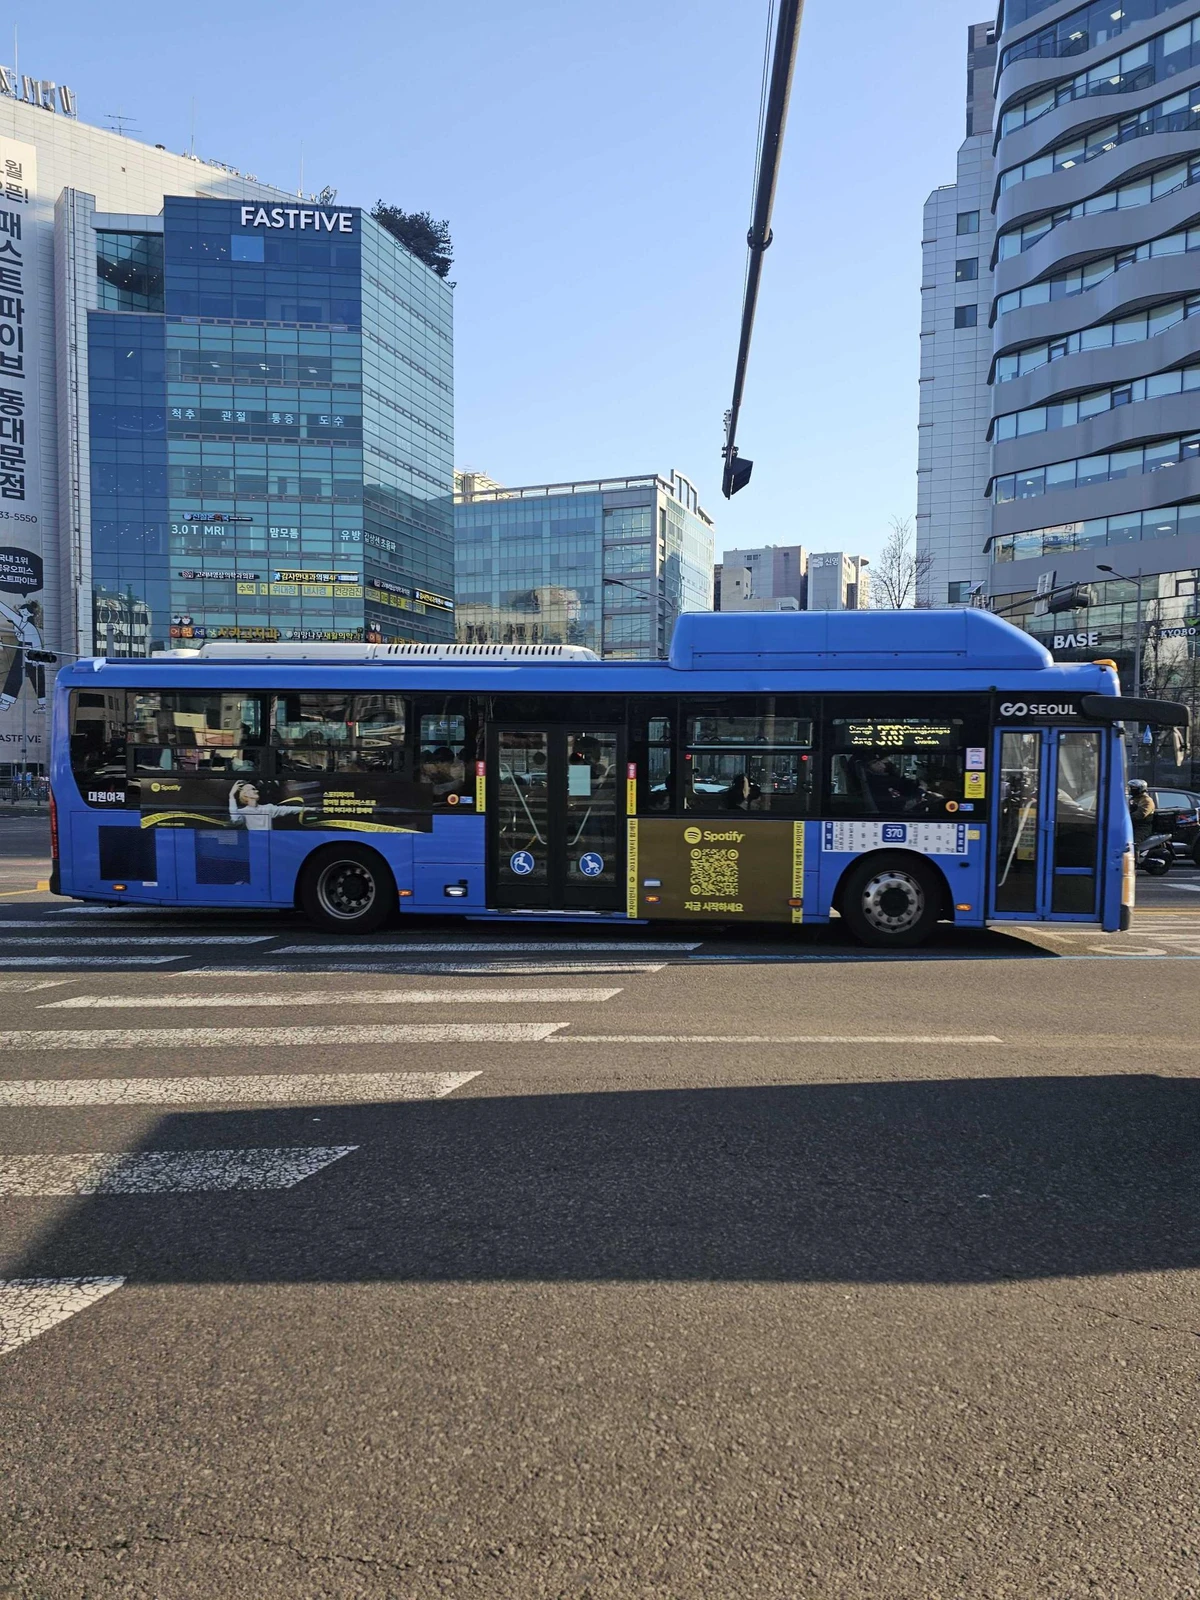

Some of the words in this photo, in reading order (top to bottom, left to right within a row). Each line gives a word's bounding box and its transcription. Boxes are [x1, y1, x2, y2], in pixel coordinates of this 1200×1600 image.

[240, 206, 353, 232] FASTFIVE
[319, 415, 344, 426] 도수
[0, 387, 26, 501] 동대문점
[204, 525, 225, 536] MRI
[340, 530, 361, 541] 유방
[272, 585, 296, 595] 위대장
[303, 586, 327, 596] 내시경
[335, 586, 362, 597] 건강검진
[1160, 627, 1197, 638] KYOBO
[1053, 632, 1099, 649] BASE
[1000, 702, 1028, 716] GO
[1029, 704, 1077, 715] SEOUL
[0, 734, 42, 744] ASTFVE
[88, 791, 125, 803] 대원여객
[703, 830, 744, 843] Spotify
[885, 828, 904, 838] 370
[702, 901, 744, 912] 시작하세요
